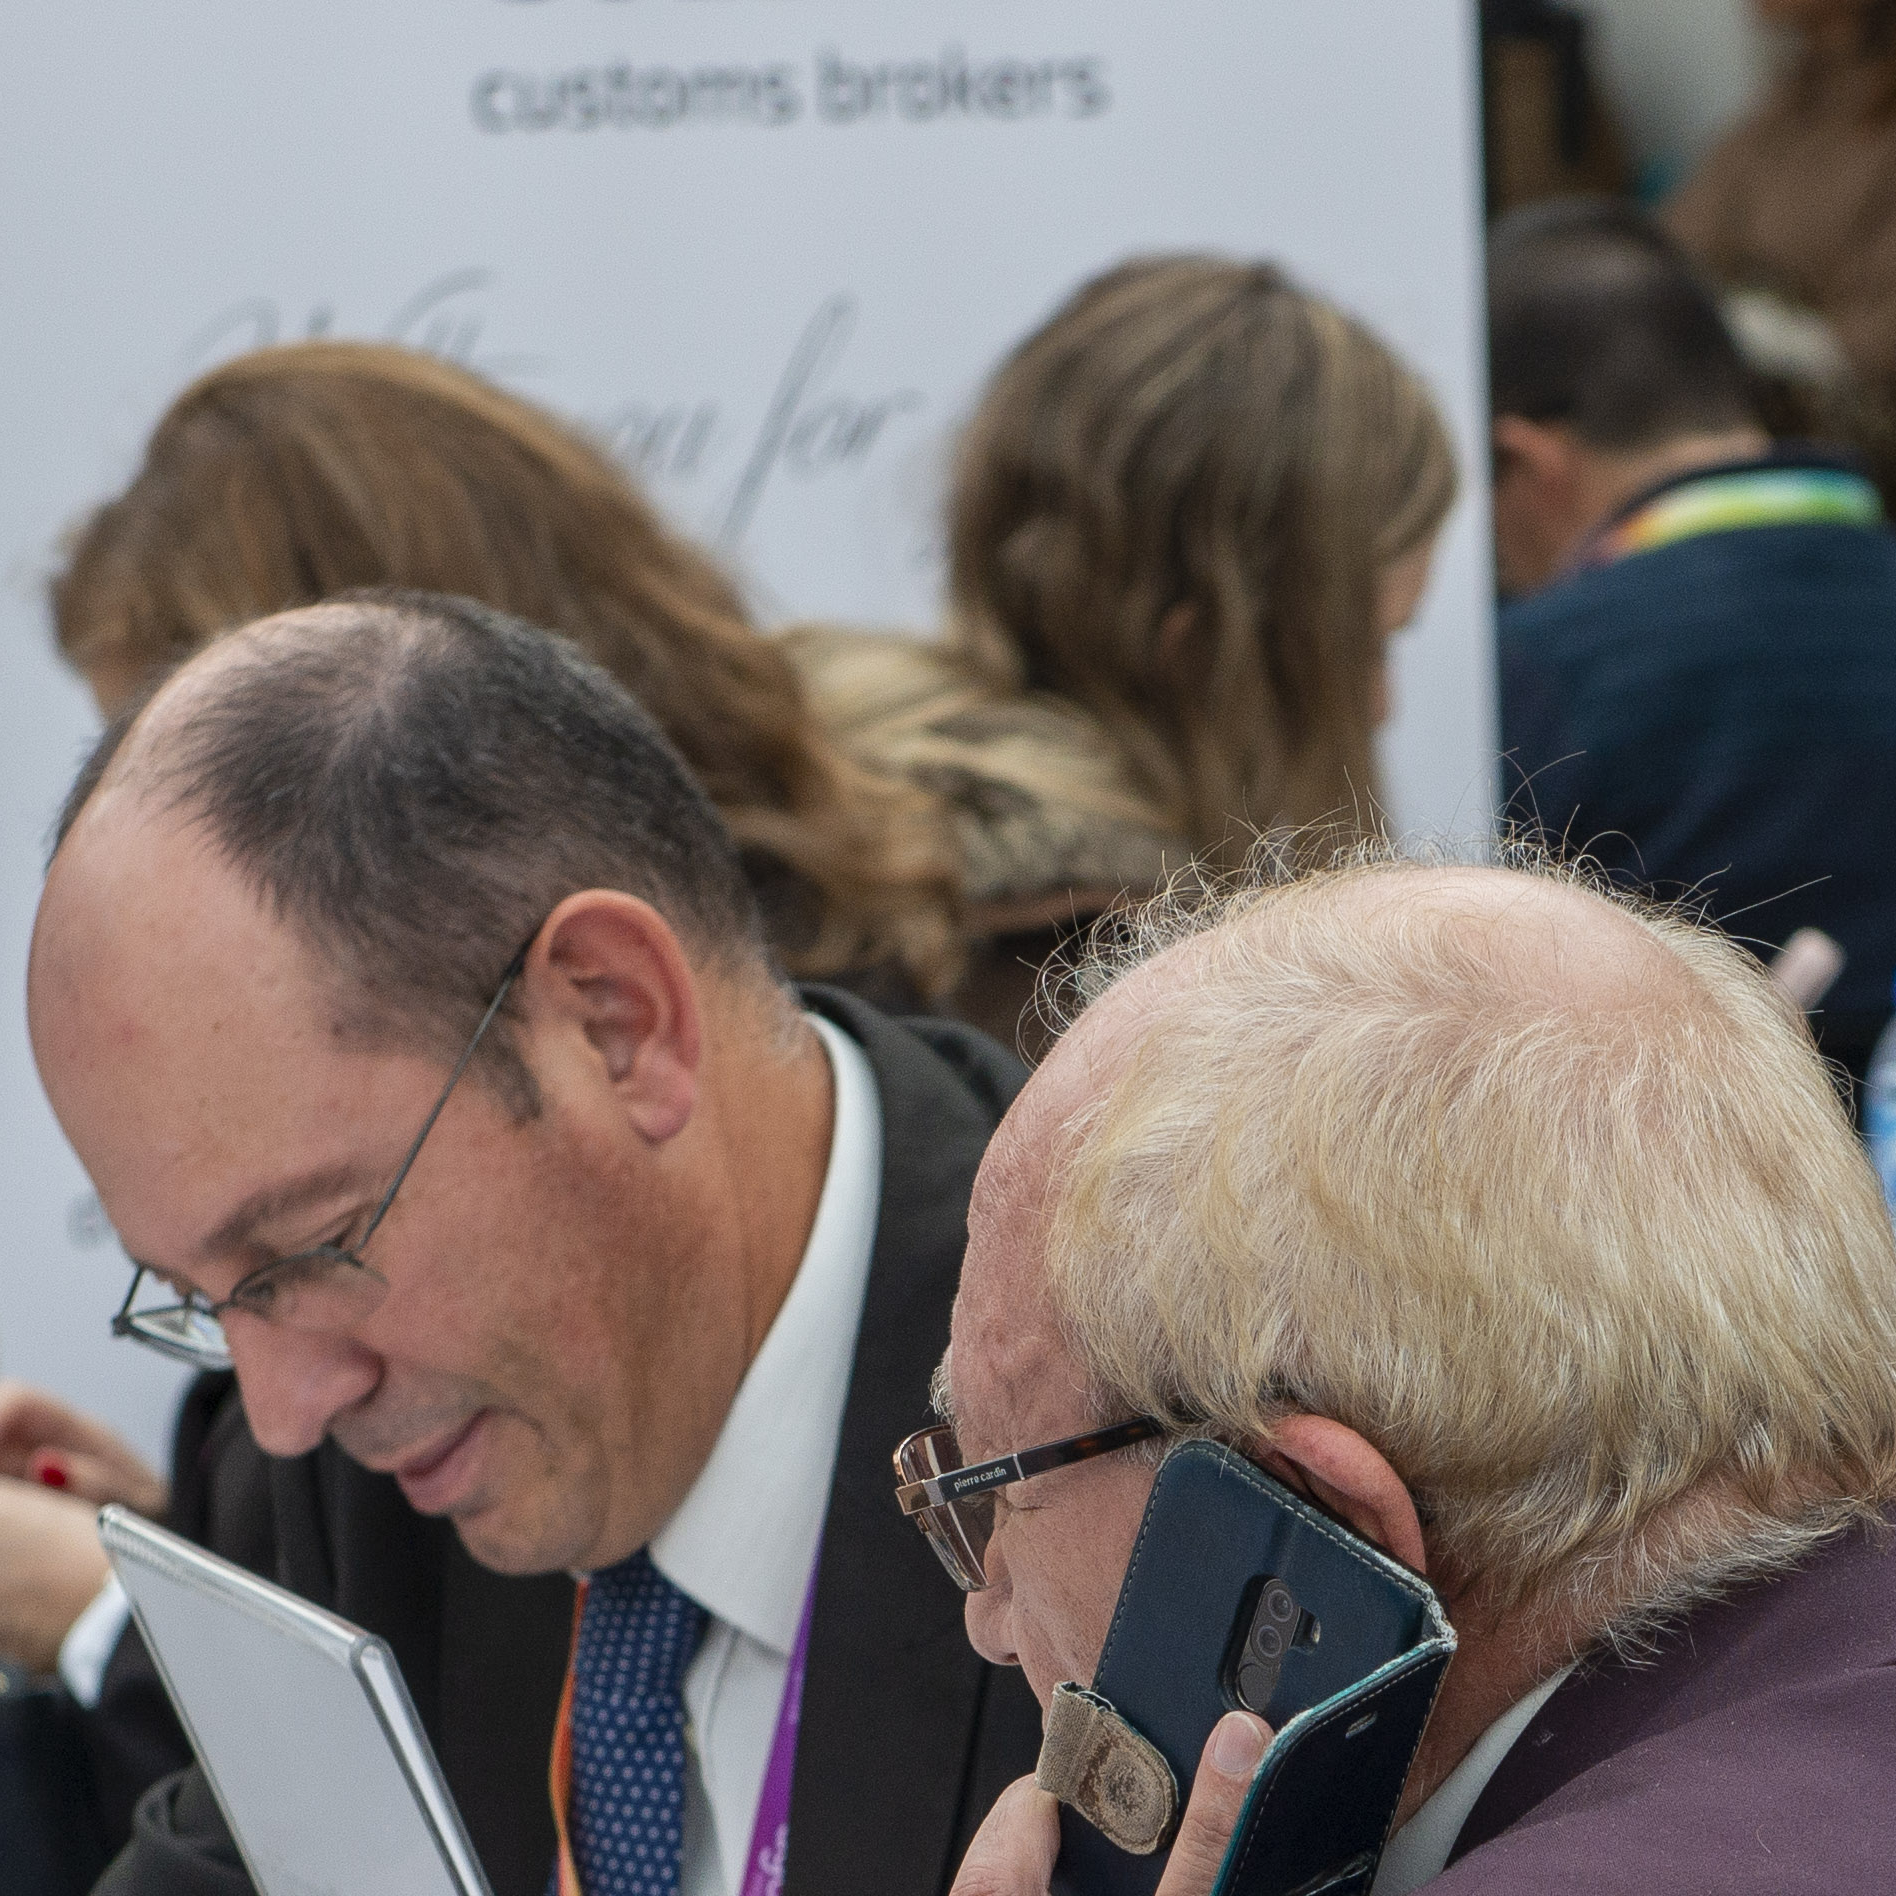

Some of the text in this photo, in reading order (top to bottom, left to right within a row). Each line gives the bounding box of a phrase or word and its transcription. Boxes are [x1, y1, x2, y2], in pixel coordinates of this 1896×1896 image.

[469, 40, 1112, 134] customs brokers
[953, 1466, 1007, 1492] pierre cardin
